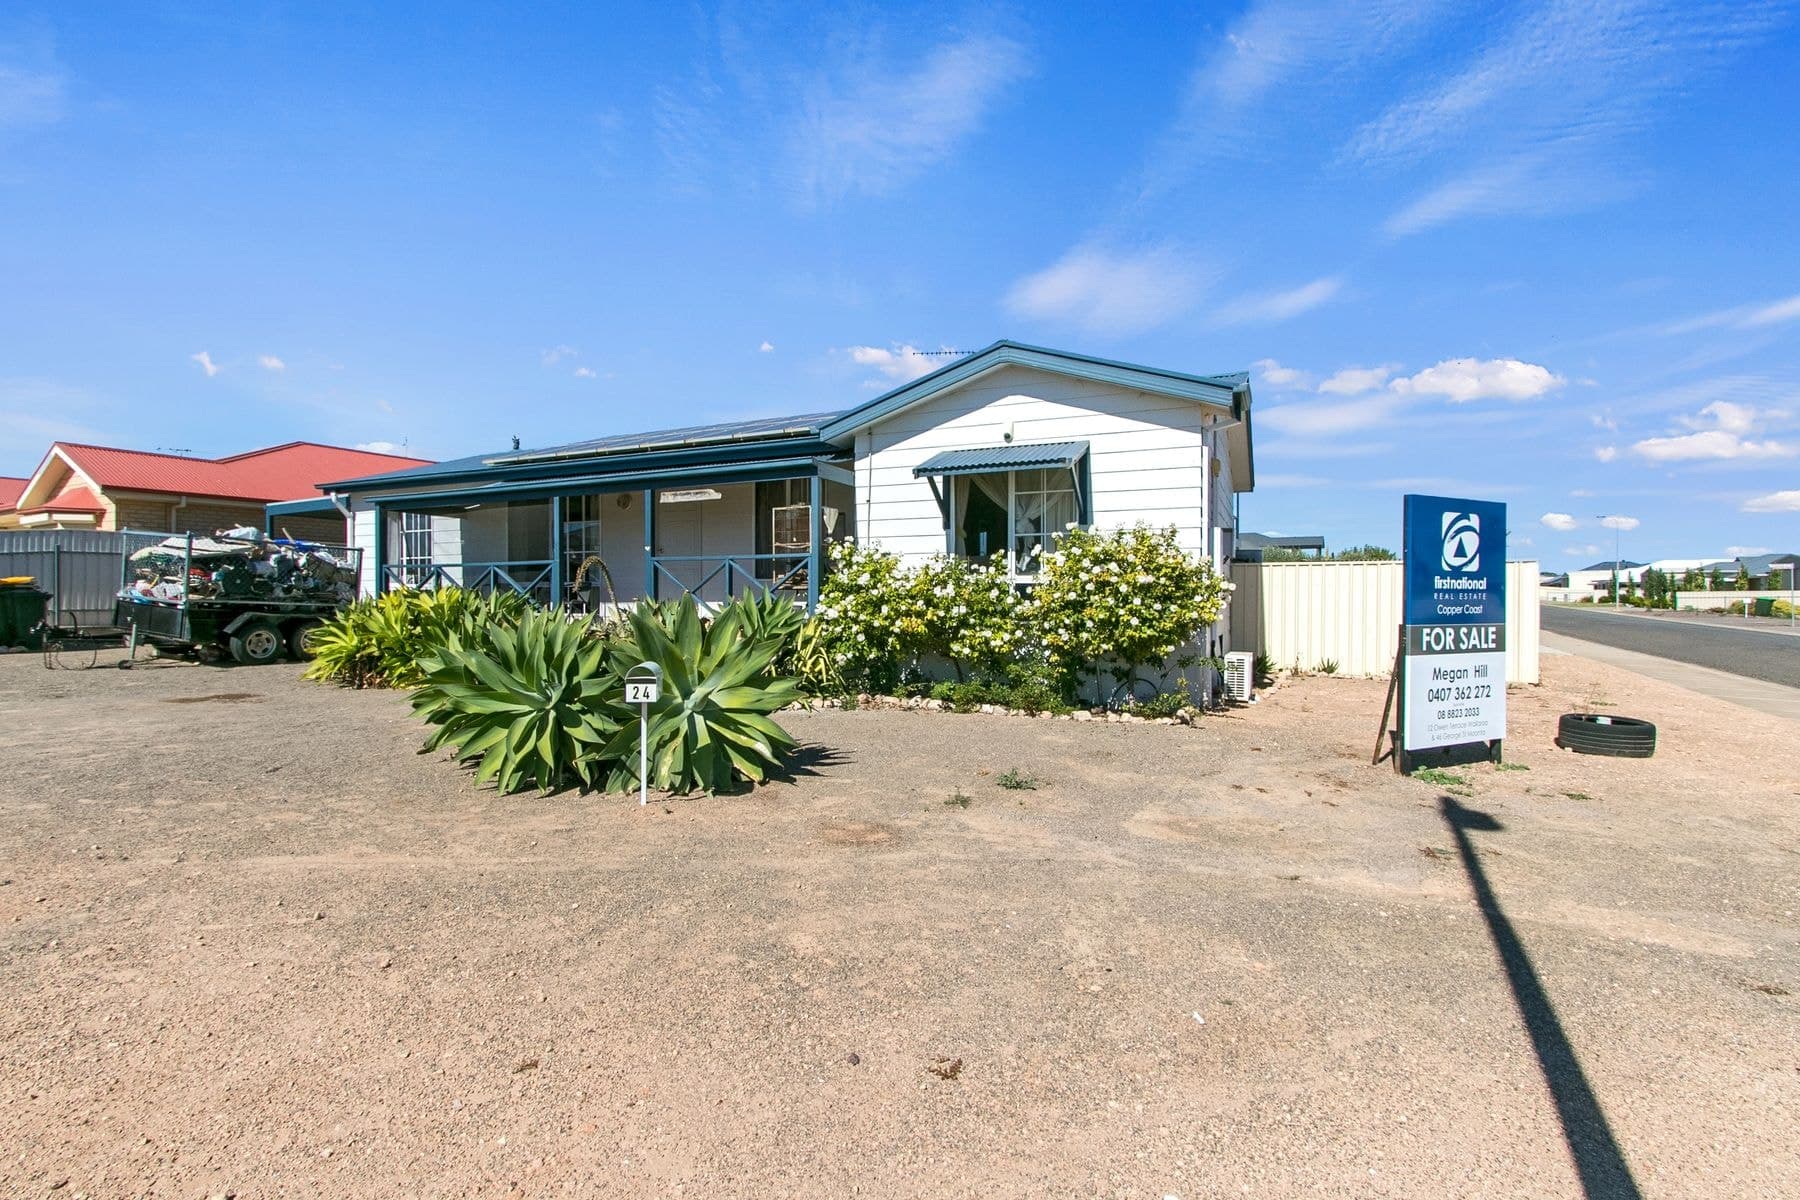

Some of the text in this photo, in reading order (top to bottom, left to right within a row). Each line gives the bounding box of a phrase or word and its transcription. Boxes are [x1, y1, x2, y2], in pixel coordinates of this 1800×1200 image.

[1434, 575, 1487, 590] firstnational
[1459, 592, 1487, 600] ESTATE
[1437, 604, 1483, 616] Copper Coast
[1422, 626, 1497, 651] FOR SALE
[1432, 664, 1488, 683] Megan Hill
[632, 685, 650, 700] 24
[1427, 685, 1491, 703] 0407 362 272
[1437, 710, 1445, 720] 08
[1447, 708, 1463, 719] 8823
